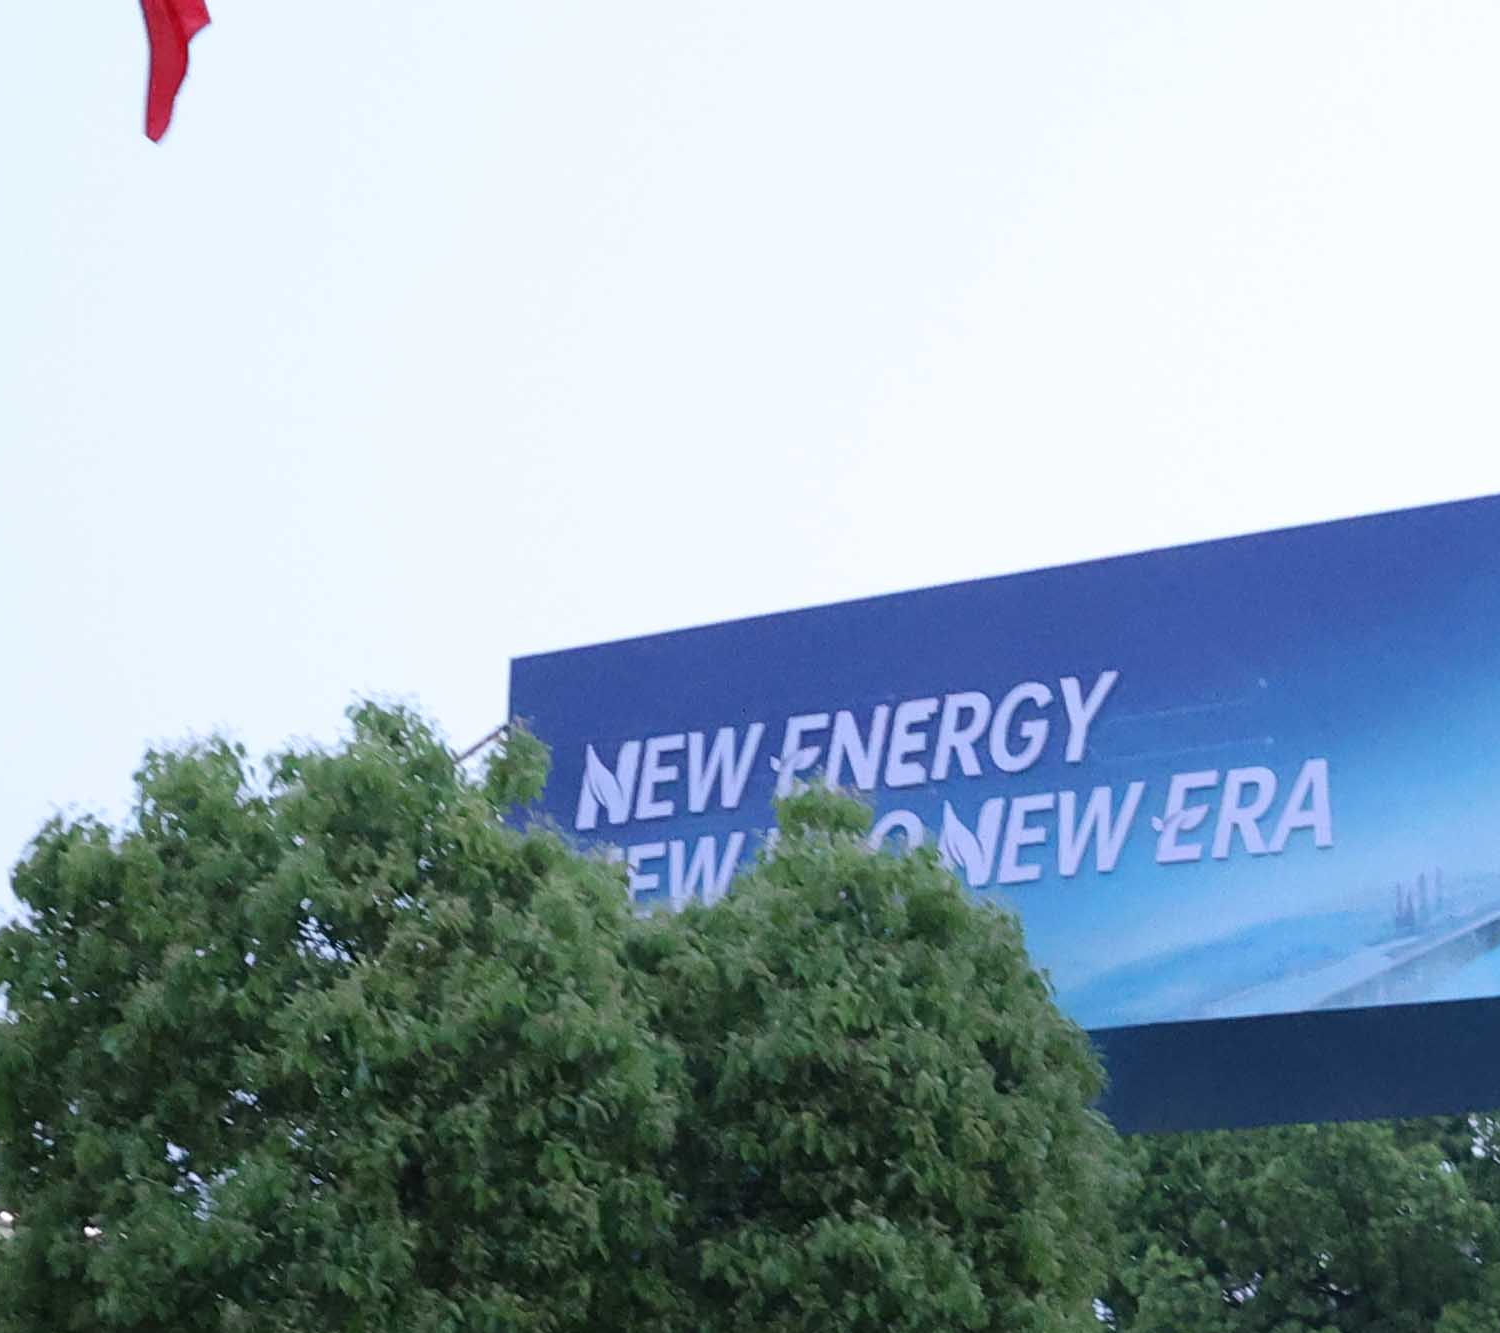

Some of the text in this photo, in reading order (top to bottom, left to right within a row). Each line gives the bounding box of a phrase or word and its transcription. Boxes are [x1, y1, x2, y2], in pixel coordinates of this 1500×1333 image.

[574, 670, 1121, 830] NEW ENERGY
[603, 830, 746, 917] EW
[941, 782, 1145, 888] NEW
[1150, 757, 1336, 864] ERA
